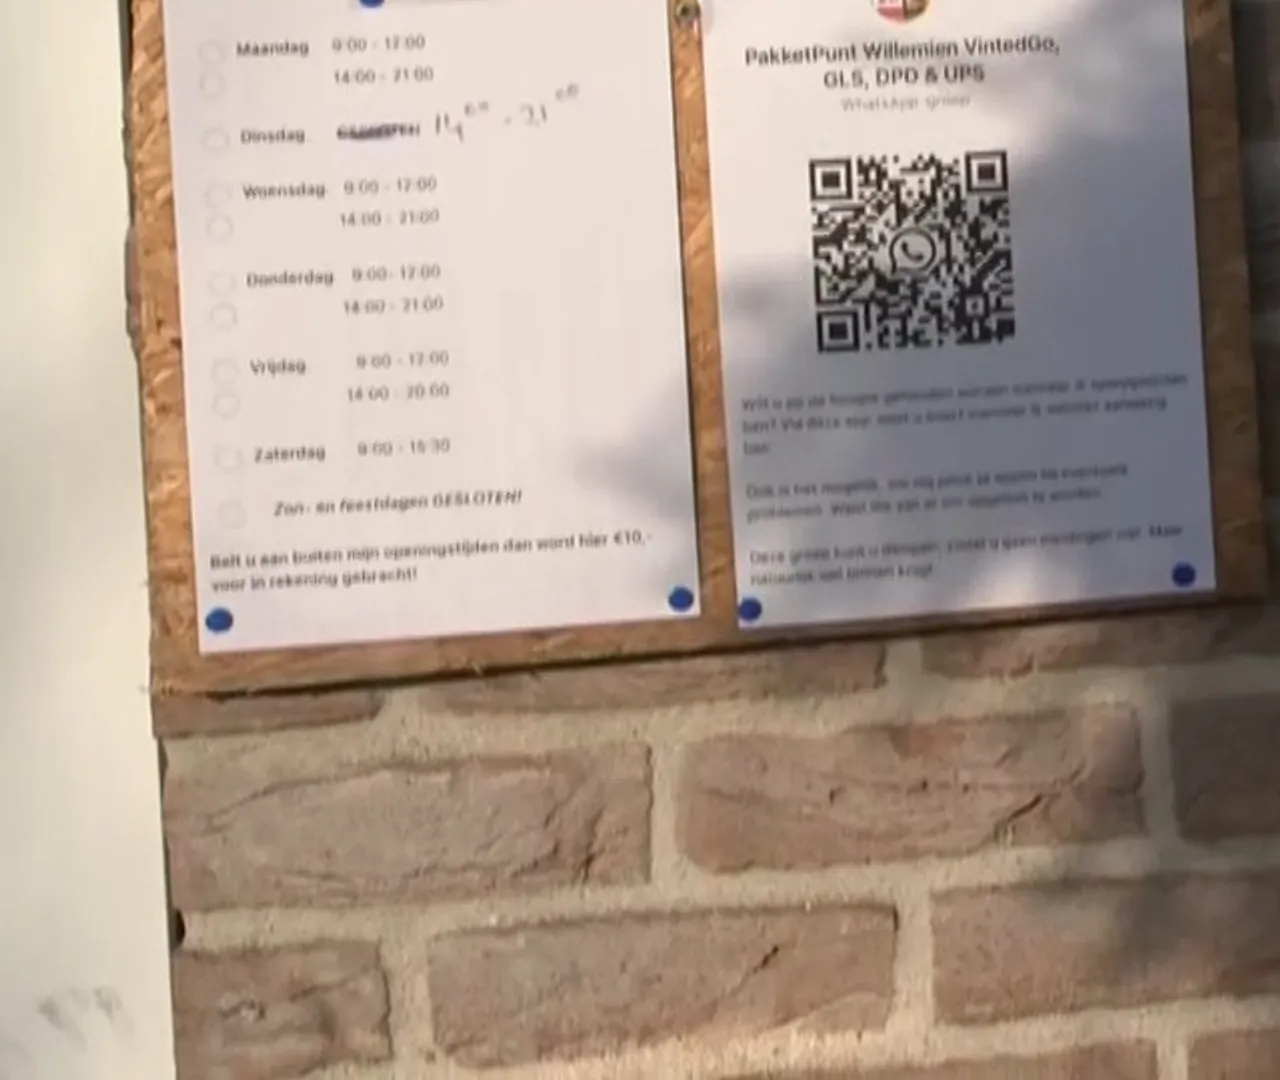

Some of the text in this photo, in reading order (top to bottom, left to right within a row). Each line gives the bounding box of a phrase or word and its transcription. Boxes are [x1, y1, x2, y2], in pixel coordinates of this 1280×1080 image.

[236, 41, 310, 59] Maandag
[385, 34, 425, 51] 12:00
[745, 44, 857, 66] PakketPunt
[862, 39, 959, 61] Willemien
[334, 69, 376, 86] 14:00
[393, 66, 434, 83] 21:00
[823, 62, 985, 90] GLS, DPD & UPS
[240, 127, 305, 145] Dinsdag
[243, 182, 326, 201] Woensdag
[396, 175, 437, 193] 12:00
[340, 211, 382, 228] 14:00
[399, 208, 440, 225] 21:00
[246, 268, 335, 288] Donderdag
[400, 264, 441, 281] 12:00
[343, 298, 386, 316] 14:00
[402, 295, 444, 313] 21:00
[249, 358, 307, 379] Vrijdag
[408, 350, 449, 367] 12:00
[347, 384, 389, 402] 14:00
[254, 444, 326, 465] Zaterdag
[340, 493, 429, 514] feestdagen
[432, 488, 523, 509] GESLOTEN!
[292, 547, 343, 565] buiten
[346, 546, 380, 563] mijn
[383, 538, 500, 561] openingstijden
[503, 537, 533, 553] dan
[579, 531, 609, 548] hier
[211, 578, 246, 594] voor
[250, 576, 267, 592] in
[269, 570, 338, 593] rekening
